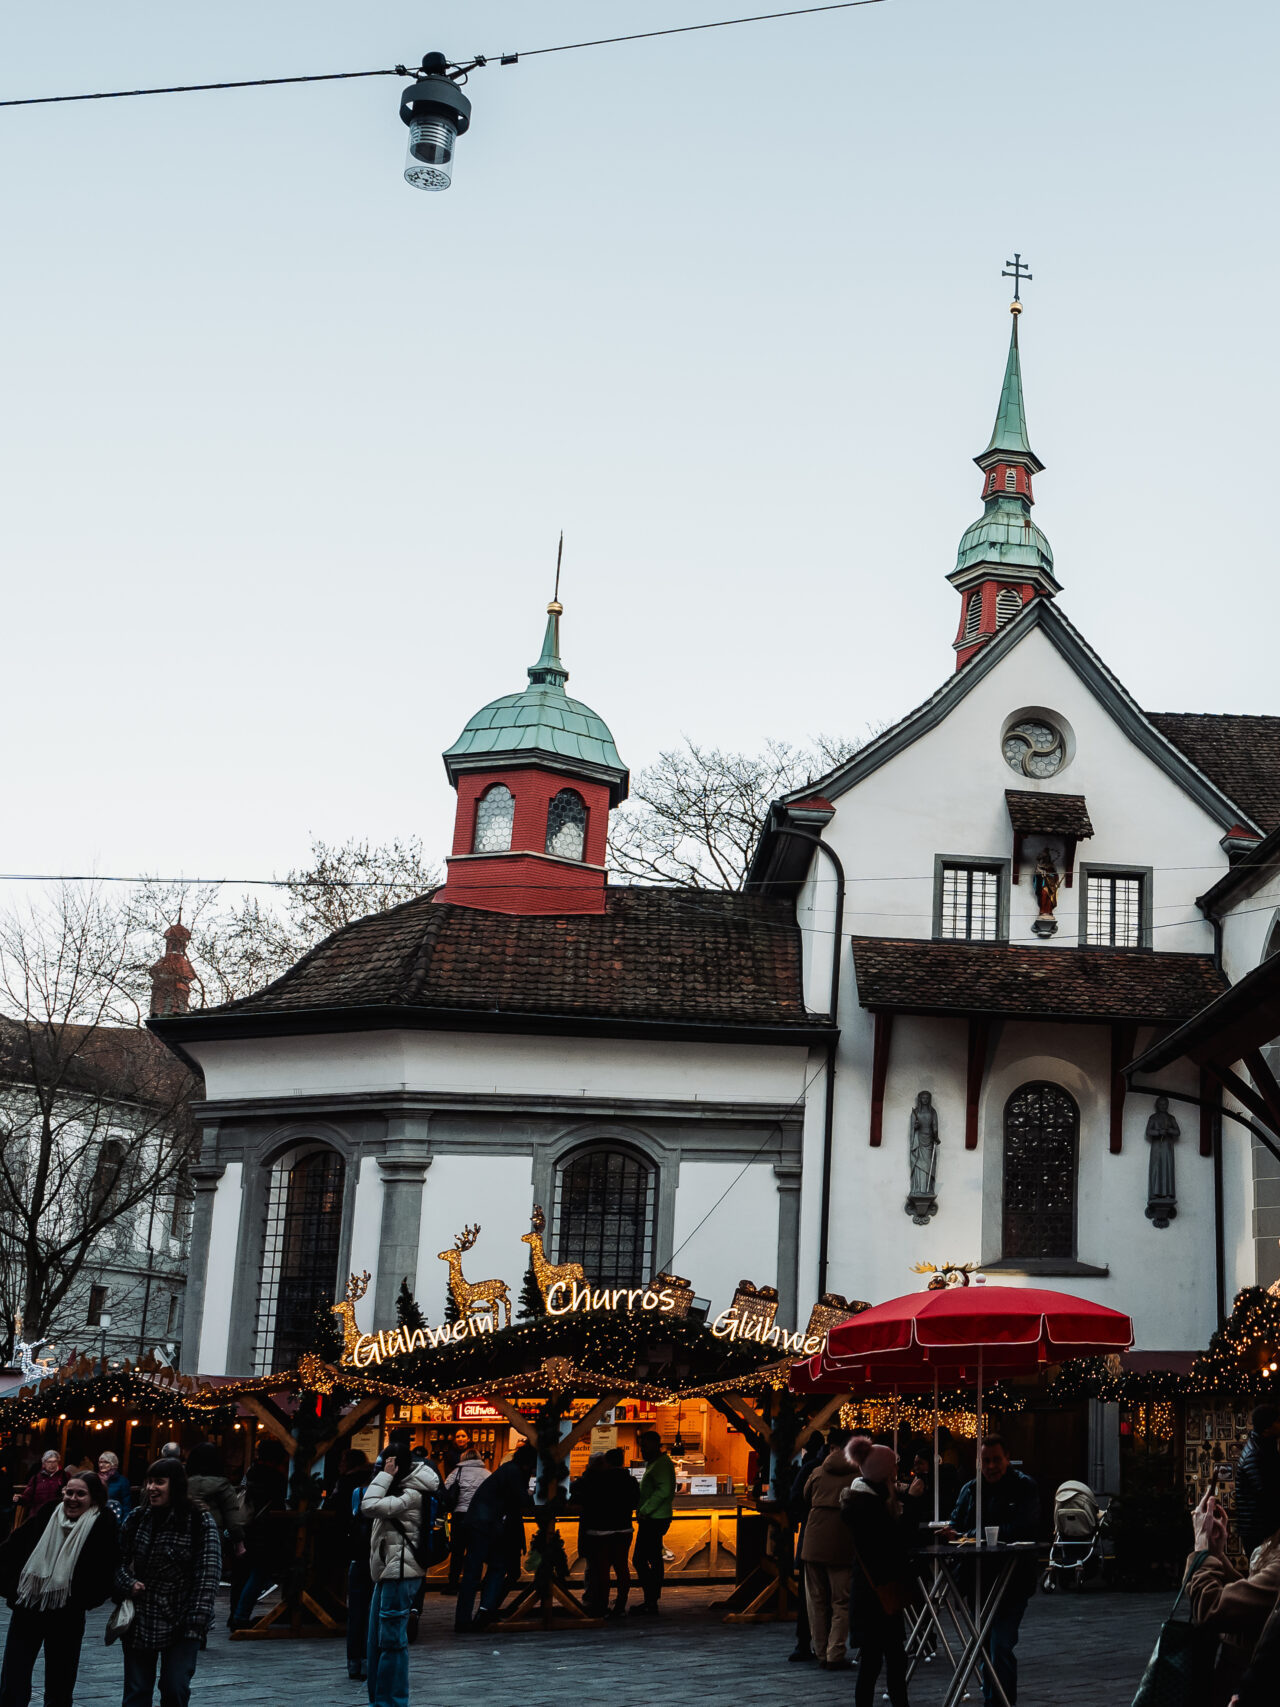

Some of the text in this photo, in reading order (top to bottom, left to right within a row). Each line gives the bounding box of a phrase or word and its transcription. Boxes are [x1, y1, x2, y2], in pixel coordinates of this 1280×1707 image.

[547, 1281, 675, 1315] Churros
[354, 1315, 494, 1368] Glühwein
[712, 1308, 827, 1354] Glühwei
